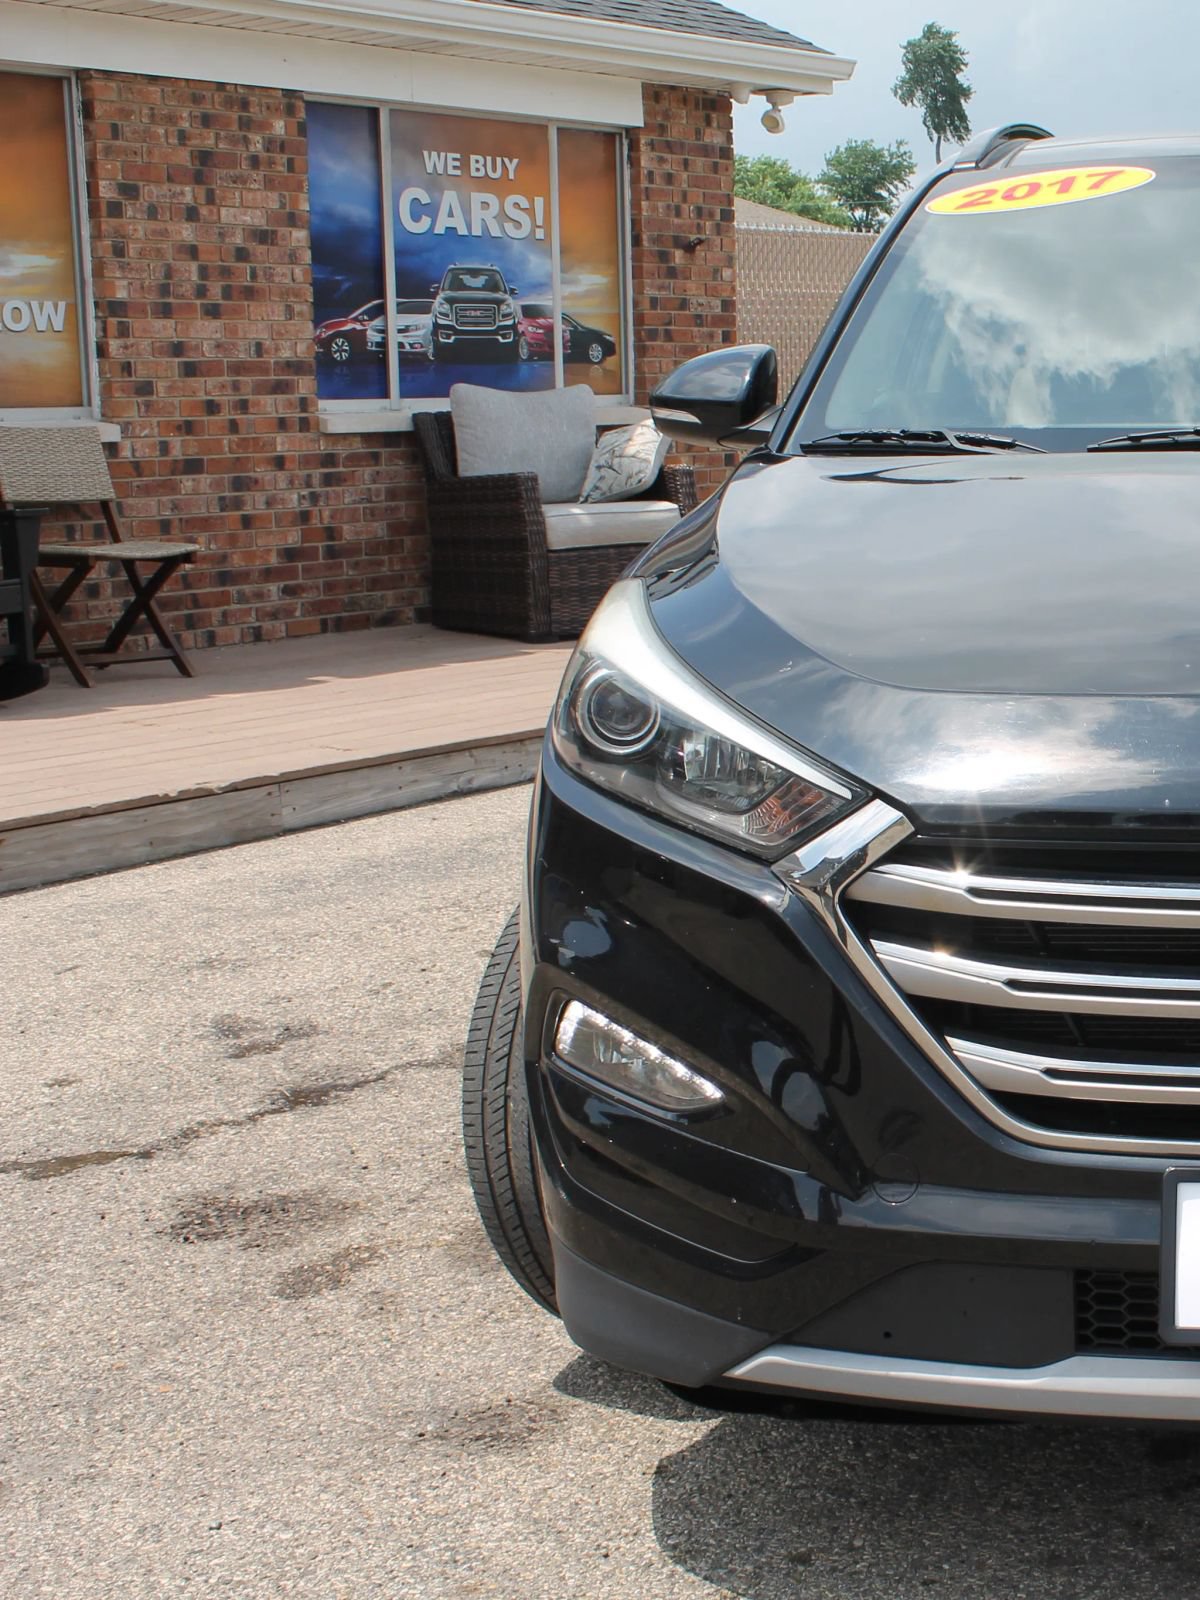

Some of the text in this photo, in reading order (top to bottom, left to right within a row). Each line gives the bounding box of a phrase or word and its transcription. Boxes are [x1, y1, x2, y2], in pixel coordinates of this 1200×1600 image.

[422, 150, 519, 180] WE BUY
[953, 170, 1125, 210] 2017
[399, 187, 545, 240] CARS!
[0, 300, 66, 332] OW
